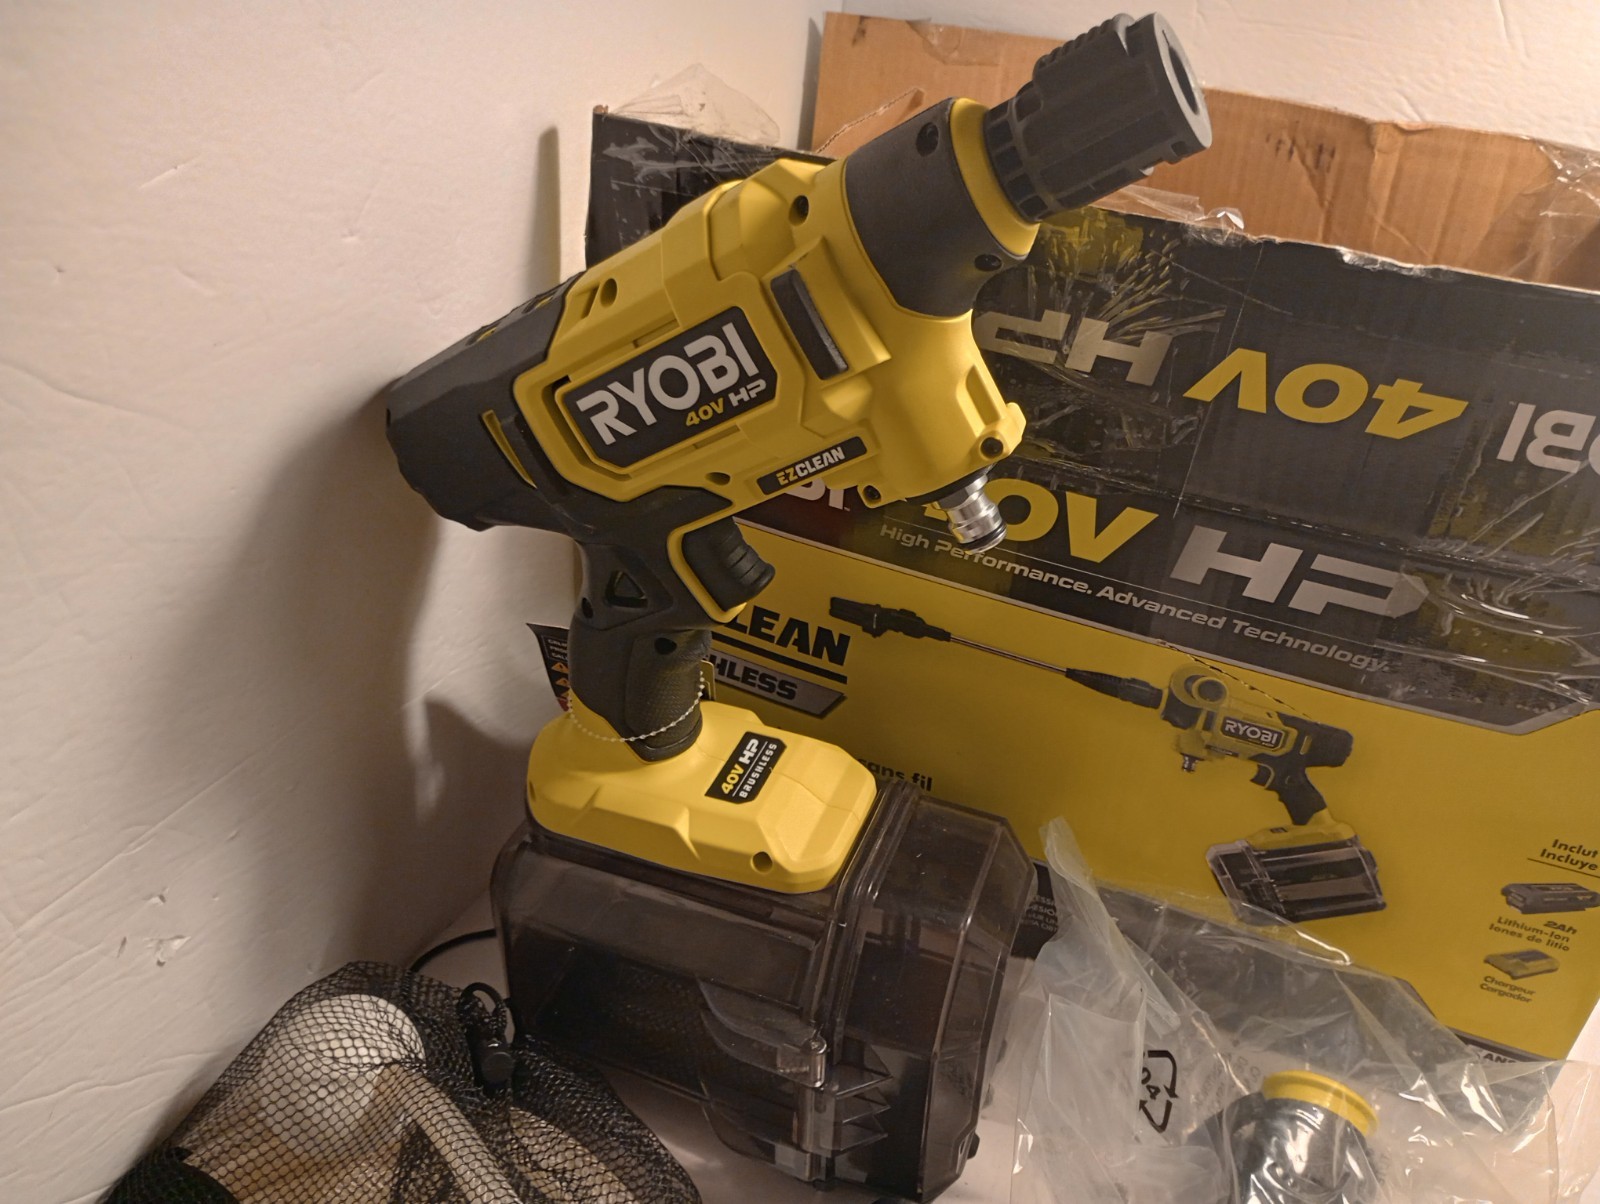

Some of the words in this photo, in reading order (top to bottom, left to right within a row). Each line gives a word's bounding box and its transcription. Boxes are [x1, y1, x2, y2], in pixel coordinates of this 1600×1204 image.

[973, 309, 1173, 386] HP
[576, 322, 759, 446] RYOBI
[685, 398, 724, 427] 40V
[728, 379, 767, 407] HP
[1182, 347, 1469, 440] 40V
[1496, 403, 1600, 475] BI
[776, 447, 846, 486] EZCLEAN
[922, 478, 1159, 563] OV
[1170, 525, 1428, 620] HP
[879, 524, 930, 548] High
[934, 539, 1093, 594] Performance.
[1096, 585, 1227, 629] Advanced
[1232, 619, 1391, 672] Technology.
[703, 652, 797, 700] HLESS
[1224, 719, 1278, 744] RYOBI
[721, 763, 744, 794] 40V
[738, 738, 759, 765] HP
[739, 743, 777, 798] BRUSHLESS
[912, 772, 932, 792] fil
[1540, 848, 1598, 871] Incluye
[1552, 839, 1598, 858] Inclut
[1497, 916, 1570, 943] Lithium-Ion
[1526, 935, 1542, 944] de
[1484, 975, 1536, 996] Chargeur
